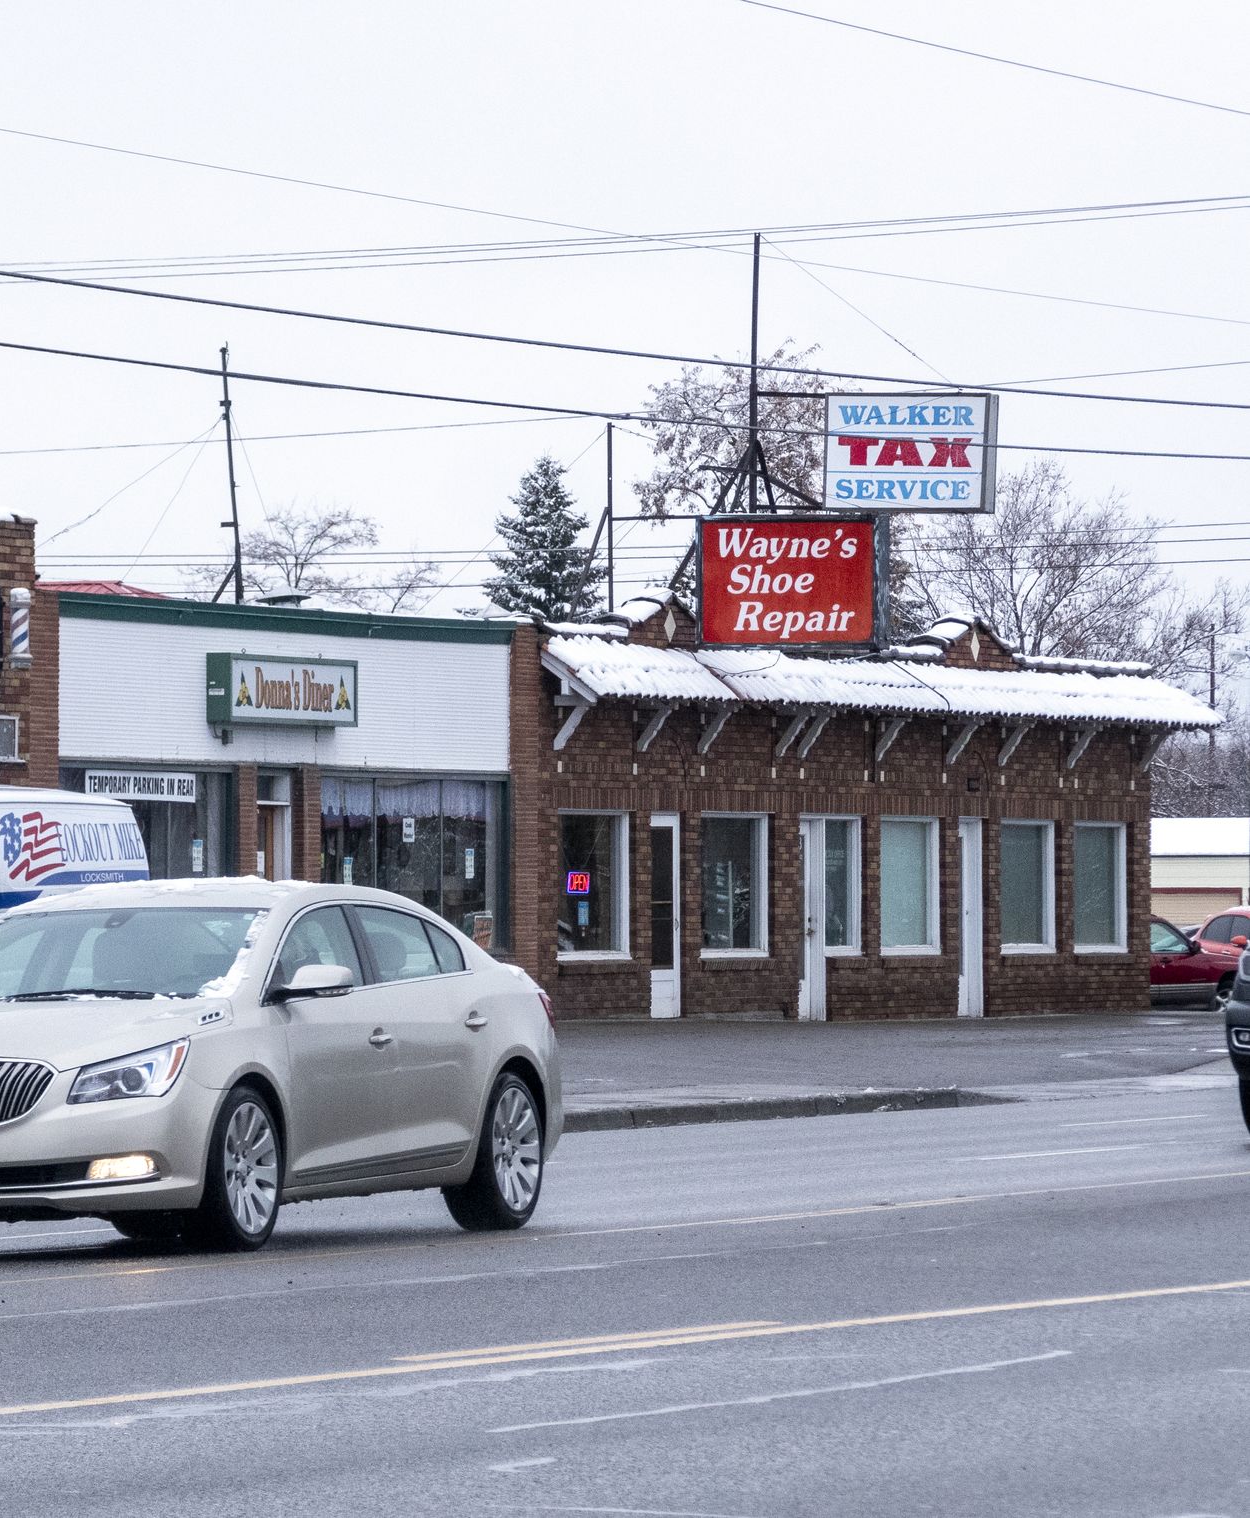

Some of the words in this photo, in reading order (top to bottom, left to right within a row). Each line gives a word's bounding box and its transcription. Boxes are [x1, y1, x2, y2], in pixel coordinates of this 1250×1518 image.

[838, 405, 974, 426] WALKER
[838, 436, 973, 467] TAX
[835, 479, 970, 500] SERVICE
[718, 528, 858, 564] Wayne's
[727, 564, 815, 595] Shoe
[733, 602, 855, 639] Repair
[255, 666, 300, 710] Donna's
[302, 669, 335, 712] Diner
[88, 775, 131, 793] TEMPORARY
[133, 777, 165, 795] PARKING
[167, 778, 175, 795] IN
[177, 779, 194, 796] REAR
[55, 822, 115, 863] LOCKOUT
[113, 822, 145, 861] MIKE
[80, 873, 124, 882] LOCKSMITH
[570, 874, 588, 891] OPEN
